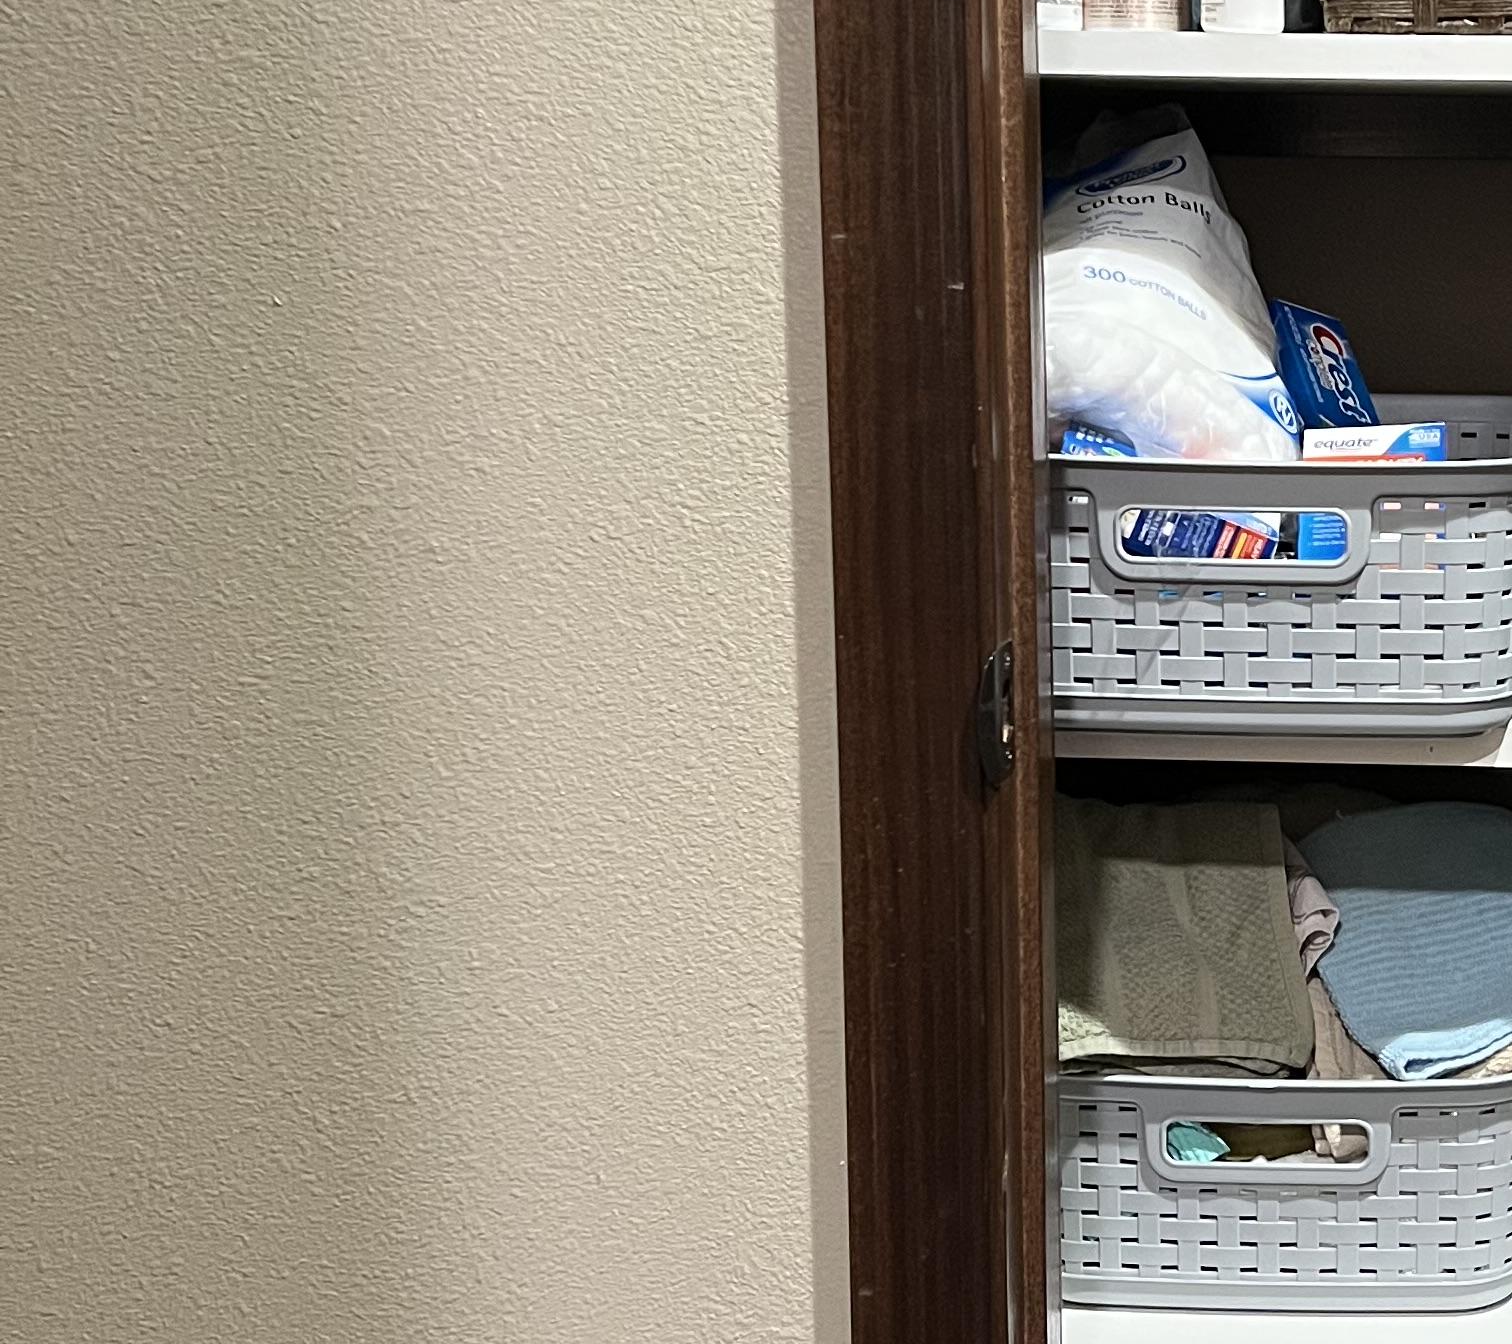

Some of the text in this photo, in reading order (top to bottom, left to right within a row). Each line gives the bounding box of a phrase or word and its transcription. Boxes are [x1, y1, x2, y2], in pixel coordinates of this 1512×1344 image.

[1077, 194, 1155, 214] Cotton
[1165, 192, 1211, 224] Balls
[1083, 265, 1207, 320] 300 COTTON BALLS
[1310, 323, 1372, 425] Crest
[1313, 437, 1373, 450] equate
